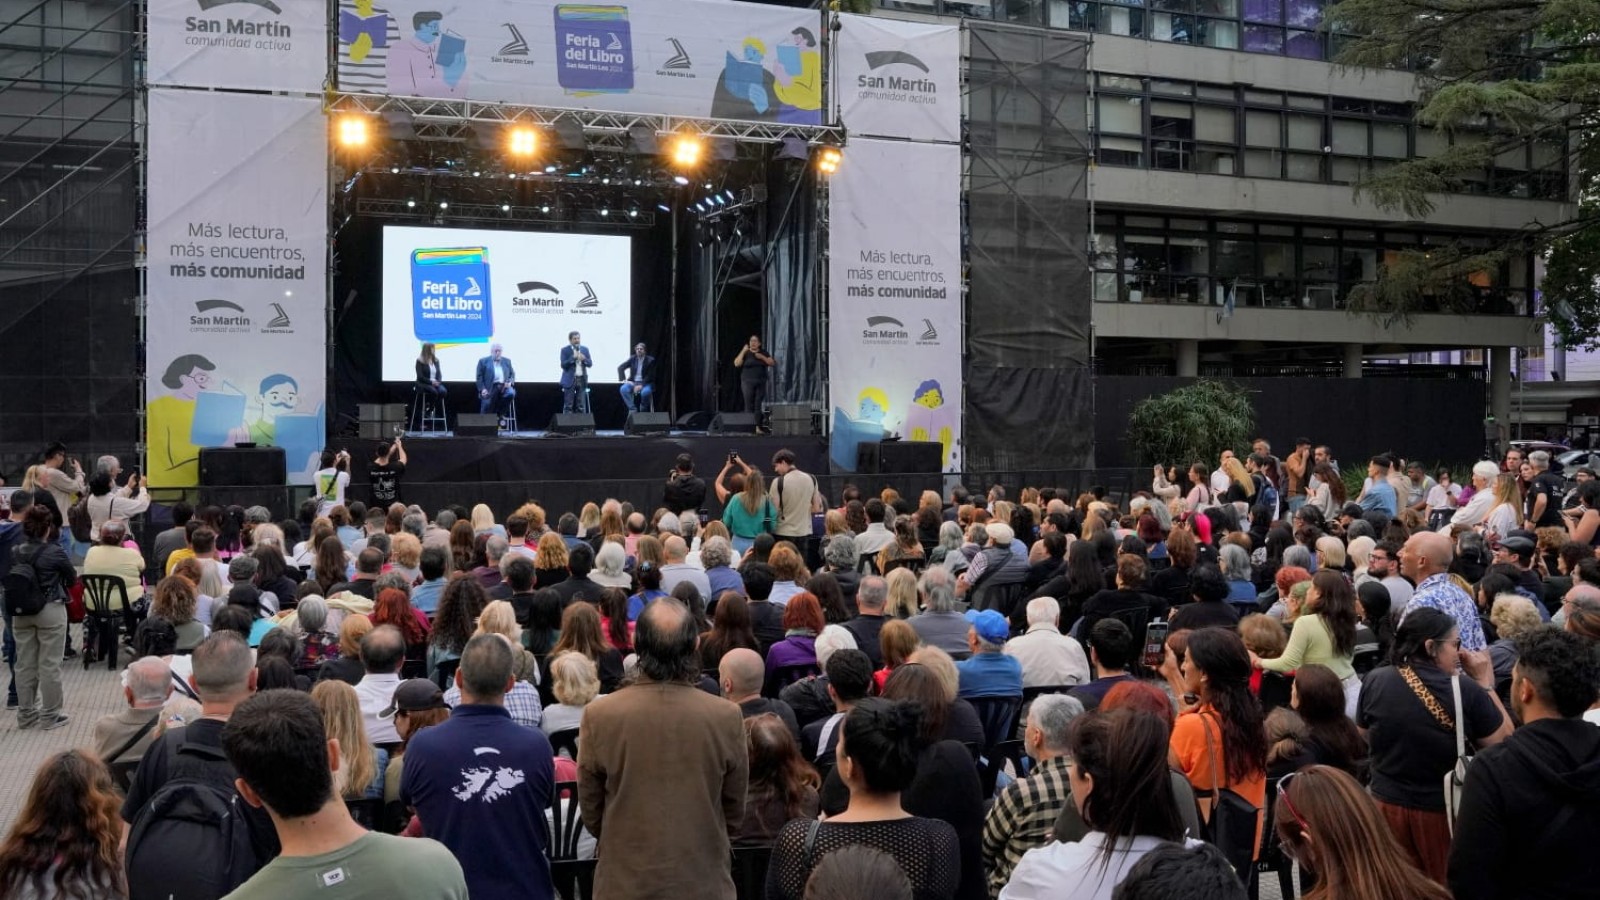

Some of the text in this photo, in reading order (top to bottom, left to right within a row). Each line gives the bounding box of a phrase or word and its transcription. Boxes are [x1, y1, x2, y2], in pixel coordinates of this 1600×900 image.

[185, 16, 291, 38] San Martín
[185, 36, 291, 51] comunidad activa
[565, 33, 600, 48] Feria
[565, 48, 624, 64] del Libro
[858, 75, 936, 93] San Martín
[858, 91, 936, 104] comunidad activa
[188, 222, 289, 242] Más lectura,
[170, 242, 305, 262] más encuentros,
[860, 249, 934, 266] Más lectura,
[170, 262, 305, 280] más comunidad
[847, 266, 946, 284] más encuentros,
[422, 280, 458, 295] Feria
[847, 283, 947, 299] más comunidad
[421, 296, 483, 311] del Libro
[512, 297, 564, 307] San Martín
[190, 315, 251, 327] San Martín
[863, 330, 908, 339] San Martín
